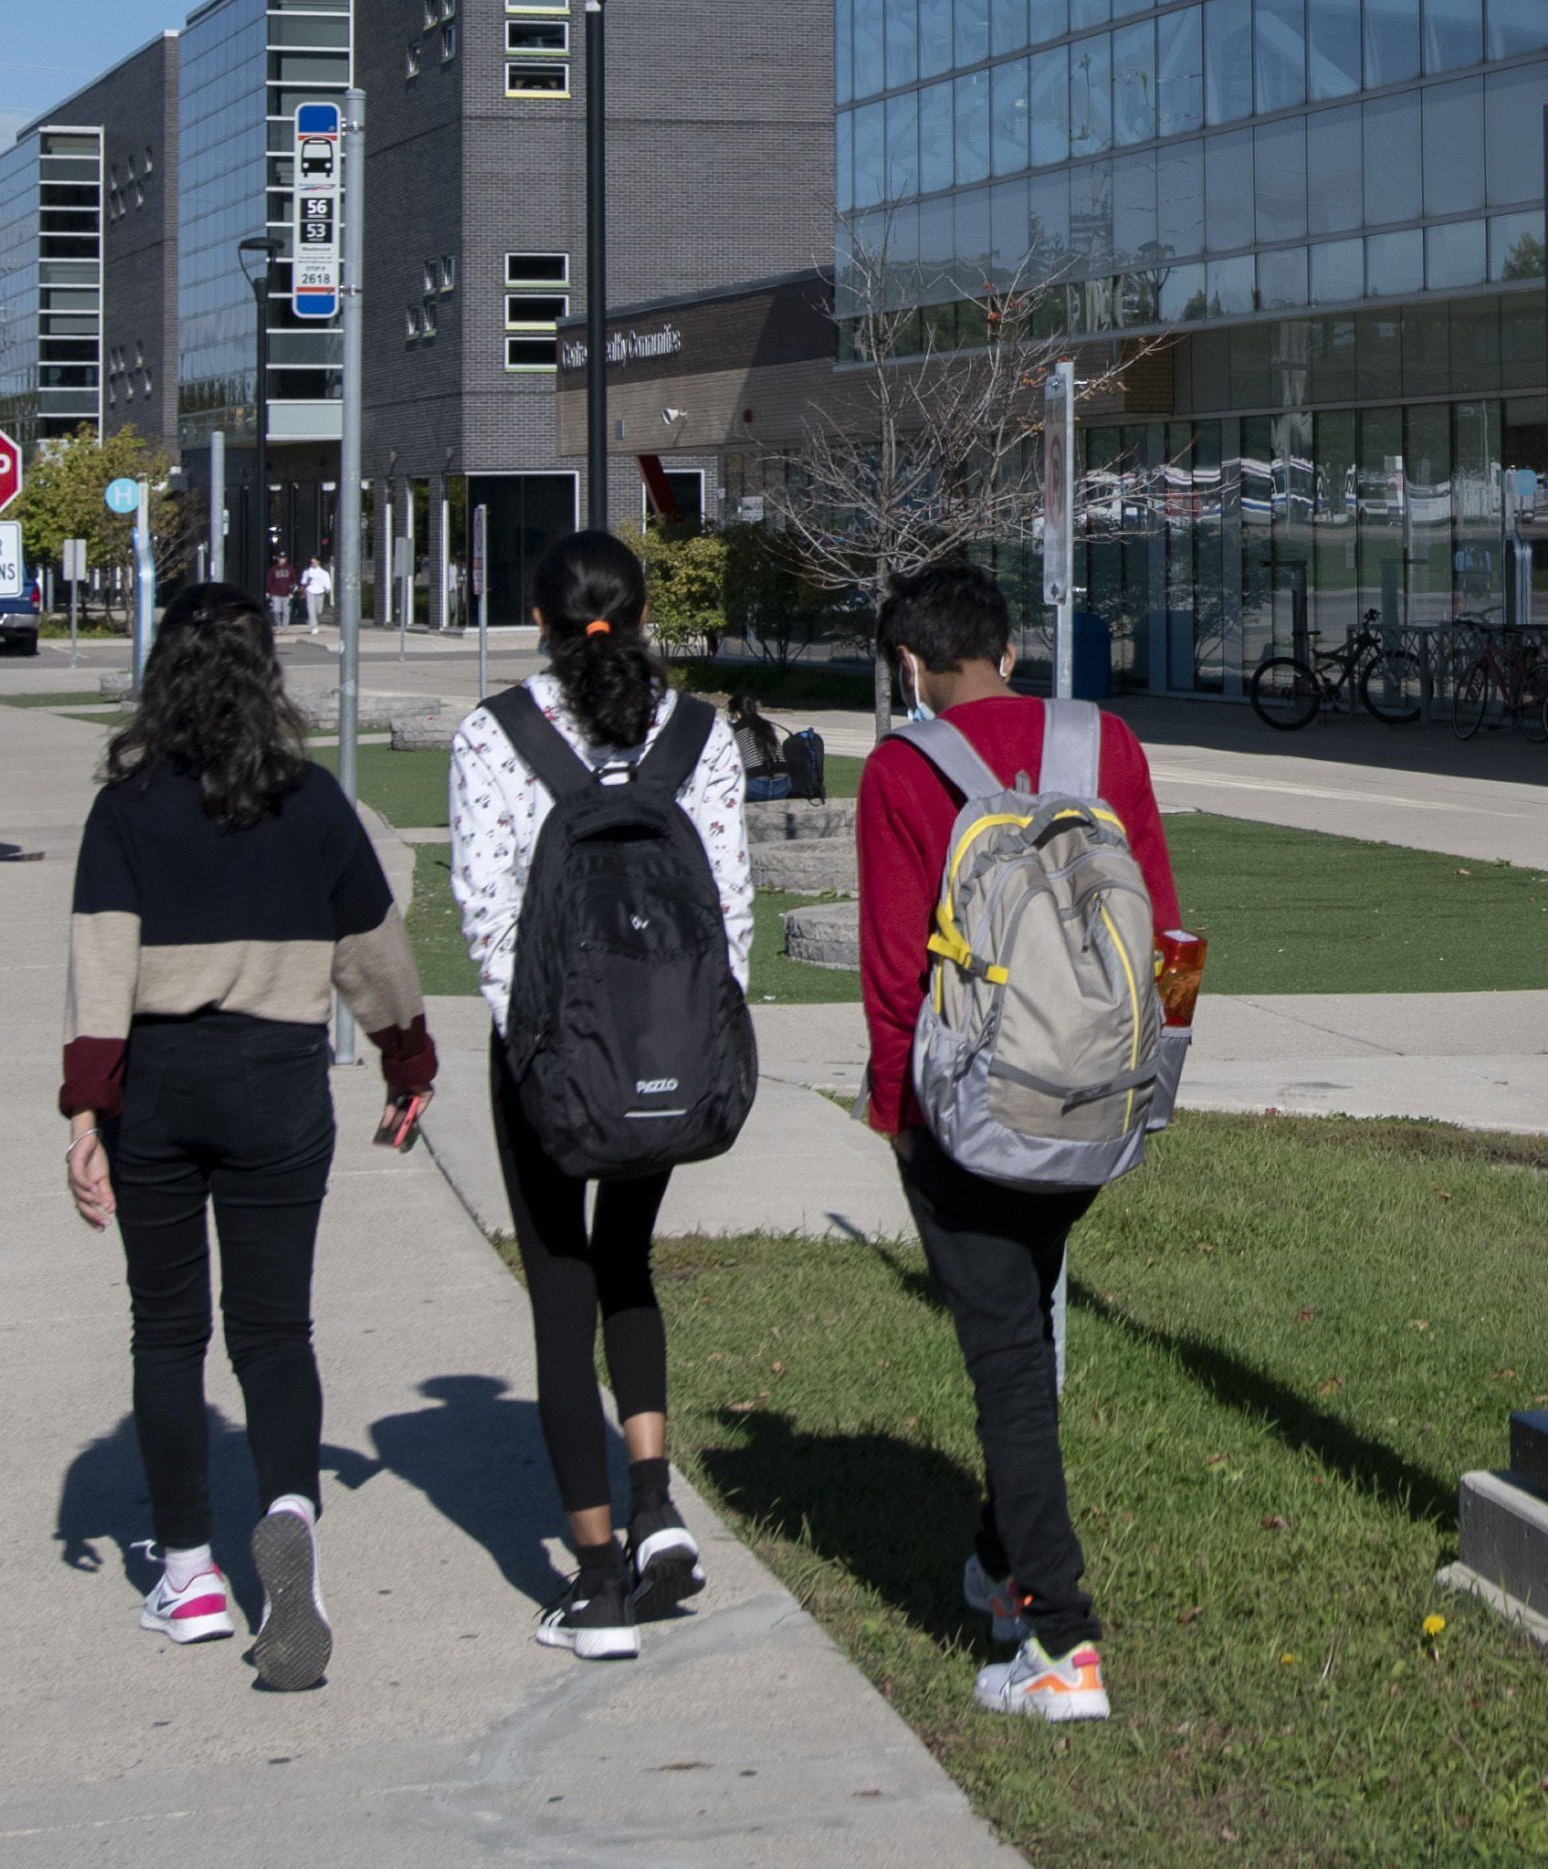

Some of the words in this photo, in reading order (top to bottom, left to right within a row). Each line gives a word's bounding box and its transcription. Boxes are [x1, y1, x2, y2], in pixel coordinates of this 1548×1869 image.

[307, 199, 327, 214] 56
[306, 223, 326, 238] 53
[301, 273, 331, 284] 2618
[628, 323, 681, 360] Communities
[113, 486, 132, 505] H
